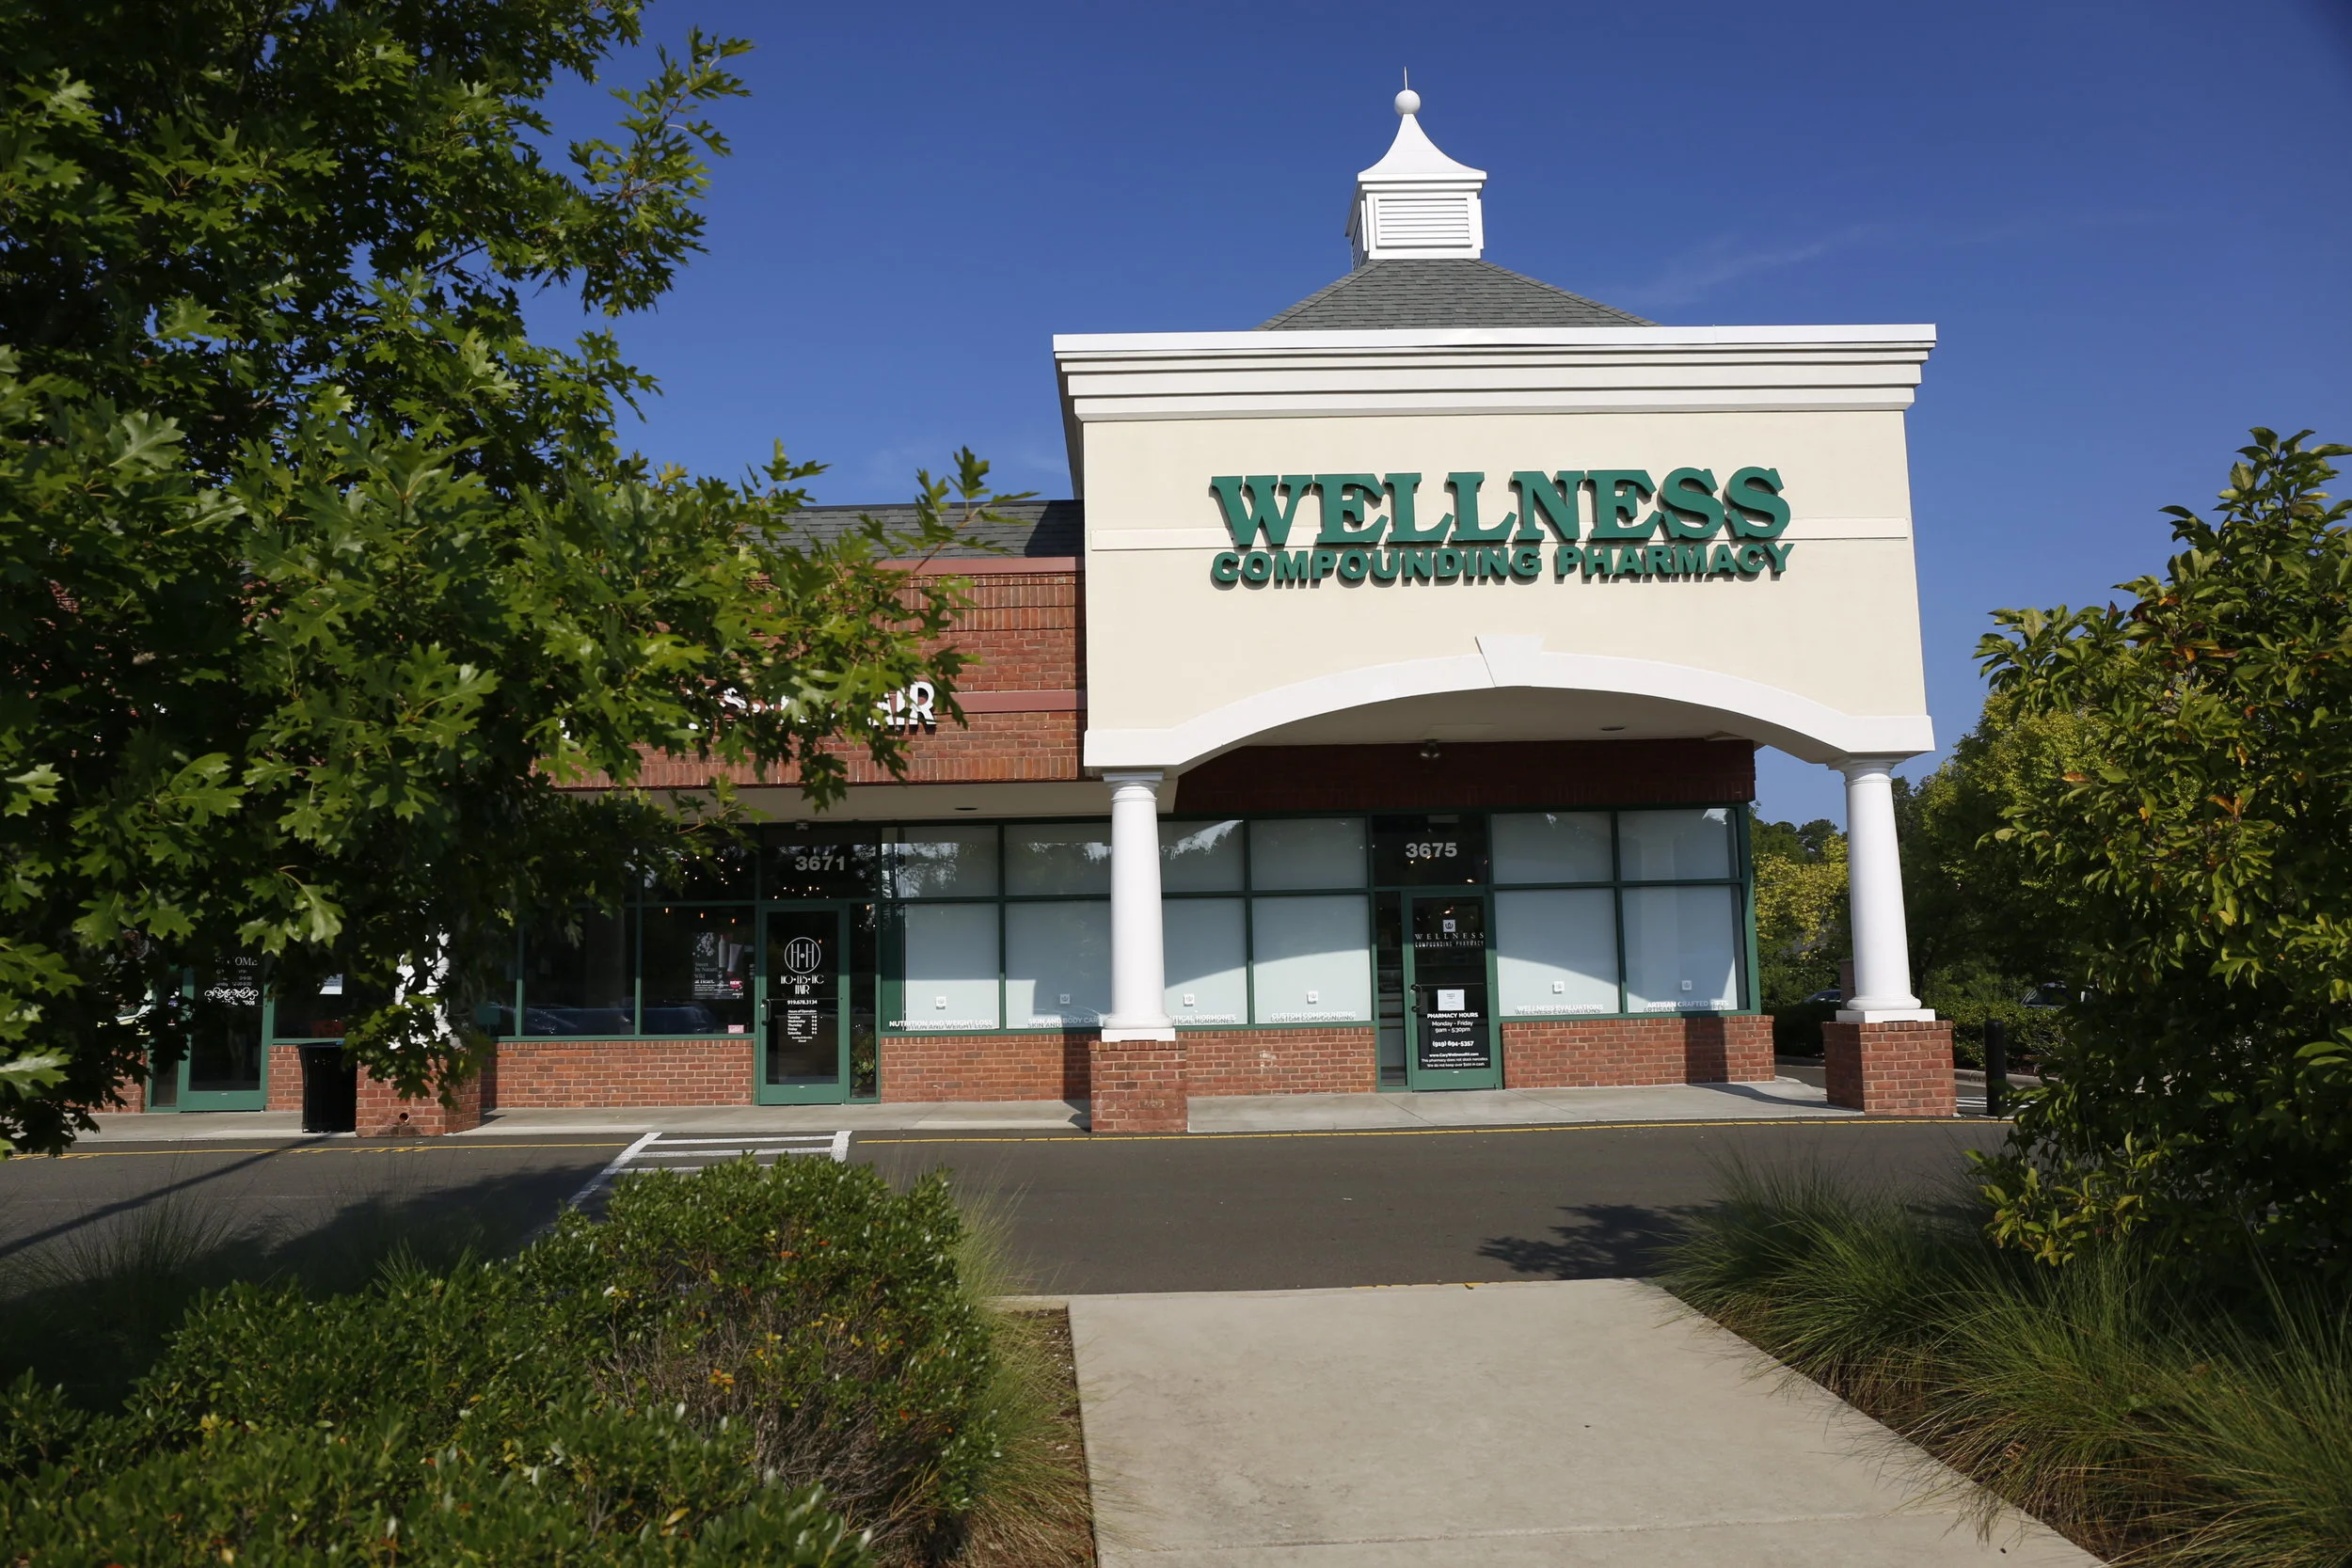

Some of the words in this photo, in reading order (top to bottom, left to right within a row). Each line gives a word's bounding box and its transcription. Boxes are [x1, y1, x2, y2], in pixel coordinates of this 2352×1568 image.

[1210, 467, 1791, 546] WELLNESS
[1212, 546, 1543, 582] COMPOUNDING
[1556, 543, 1794, 578] PHARMACY
[1406, 842, 1457, 858] 3675
[795, 855, 845, 871] 3671
[1414, 932, 1485, 941] WELLNESS
